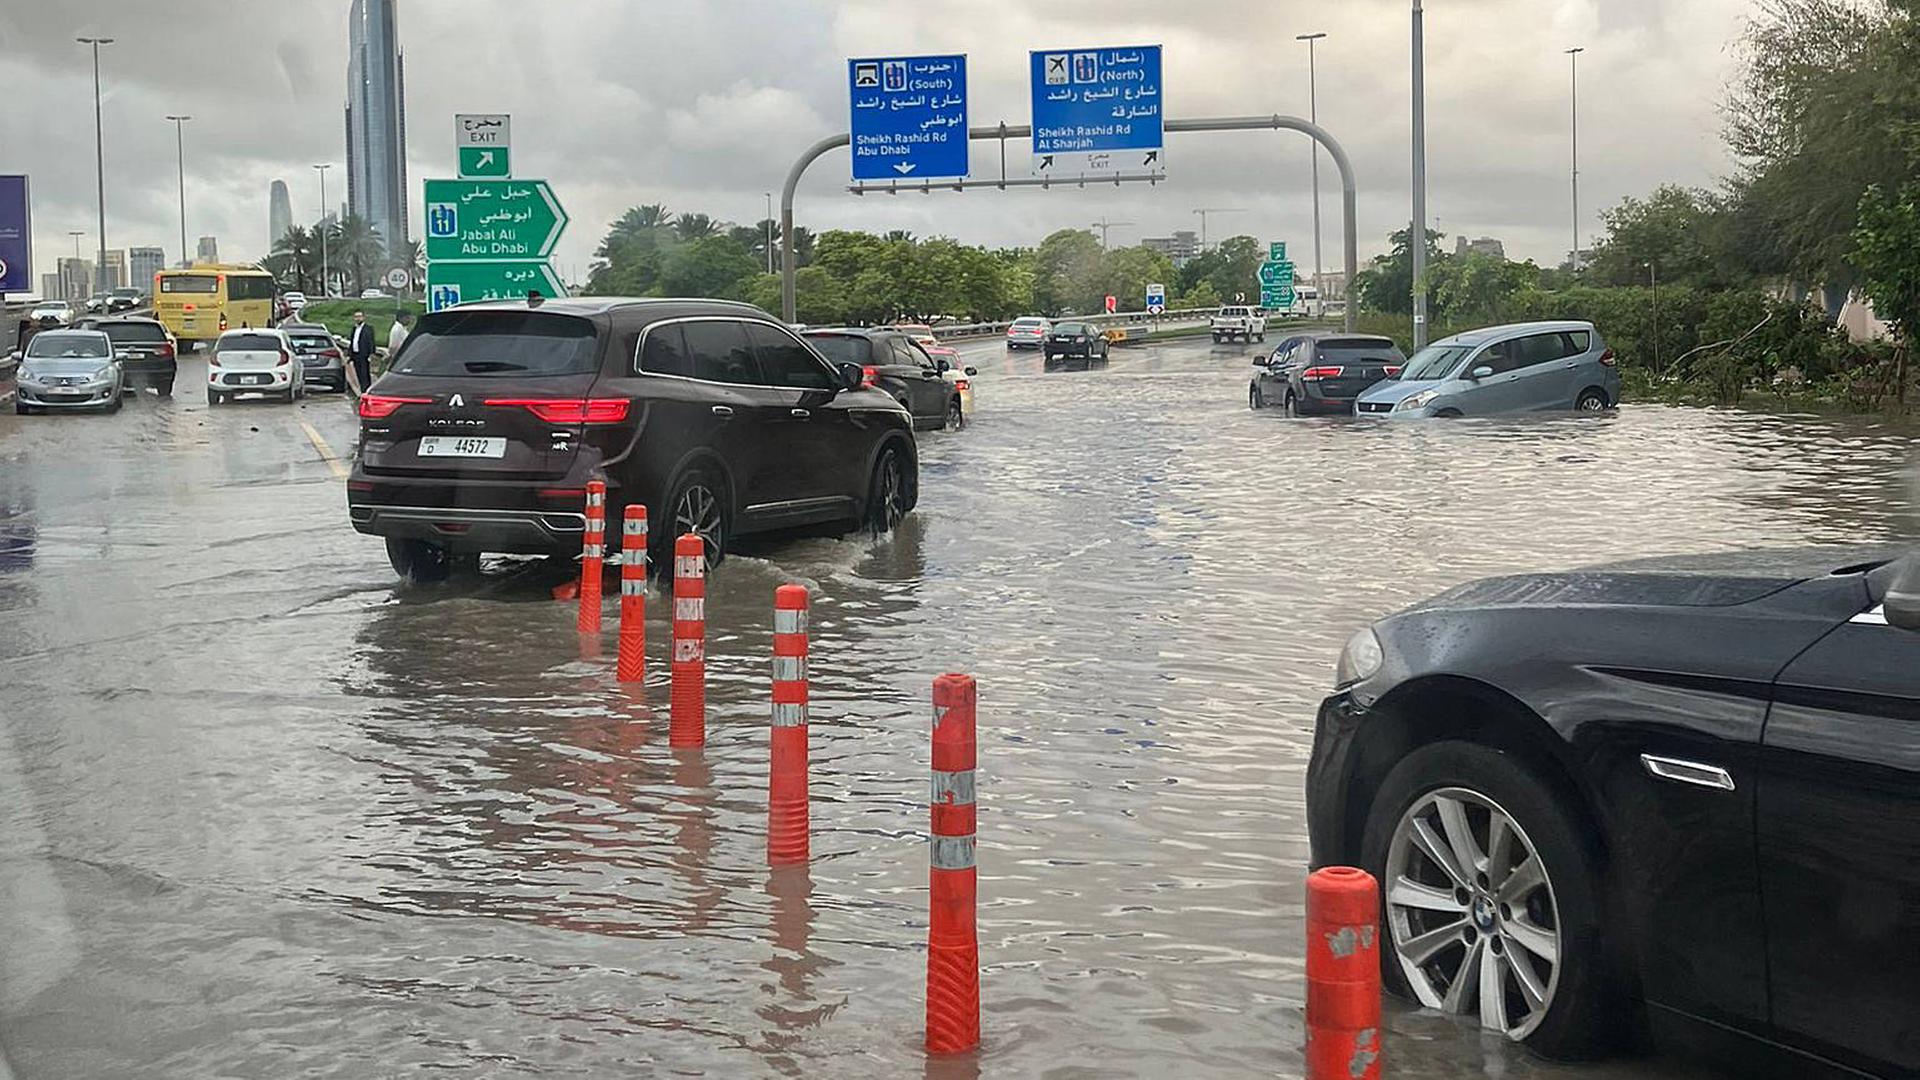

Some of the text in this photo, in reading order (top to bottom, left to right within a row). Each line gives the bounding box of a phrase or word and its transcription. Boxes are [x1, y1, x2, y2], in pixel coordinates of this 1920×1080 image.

[1100, 69, 1144, 83] (North)
[909, 78, 952, 91] (South)
[1047, 85, 1157, 102] شارع الشيخ راشد
[856, 94, 962, 111] شارع الشيخ راشد
[1111, 104, 1157, 119] الشارقة
[470, 132, 497, 142] EXIT
[1038, 124, 1131, 138] Sheikh Rashid Rd
[857, 132, 947, 145] Sheikh Rashid Rd
[1038, 138, 1094, 149] Al Sharjah
[857, 144, 911, 156] Abu Dhabi
[461, 185, 531, 205] جبل علي
[460, 229, 516, 241] Jabal Ali
[462, 241, 529, 254] Abu Dhabi
[455, 439, 489, 454] 44572
